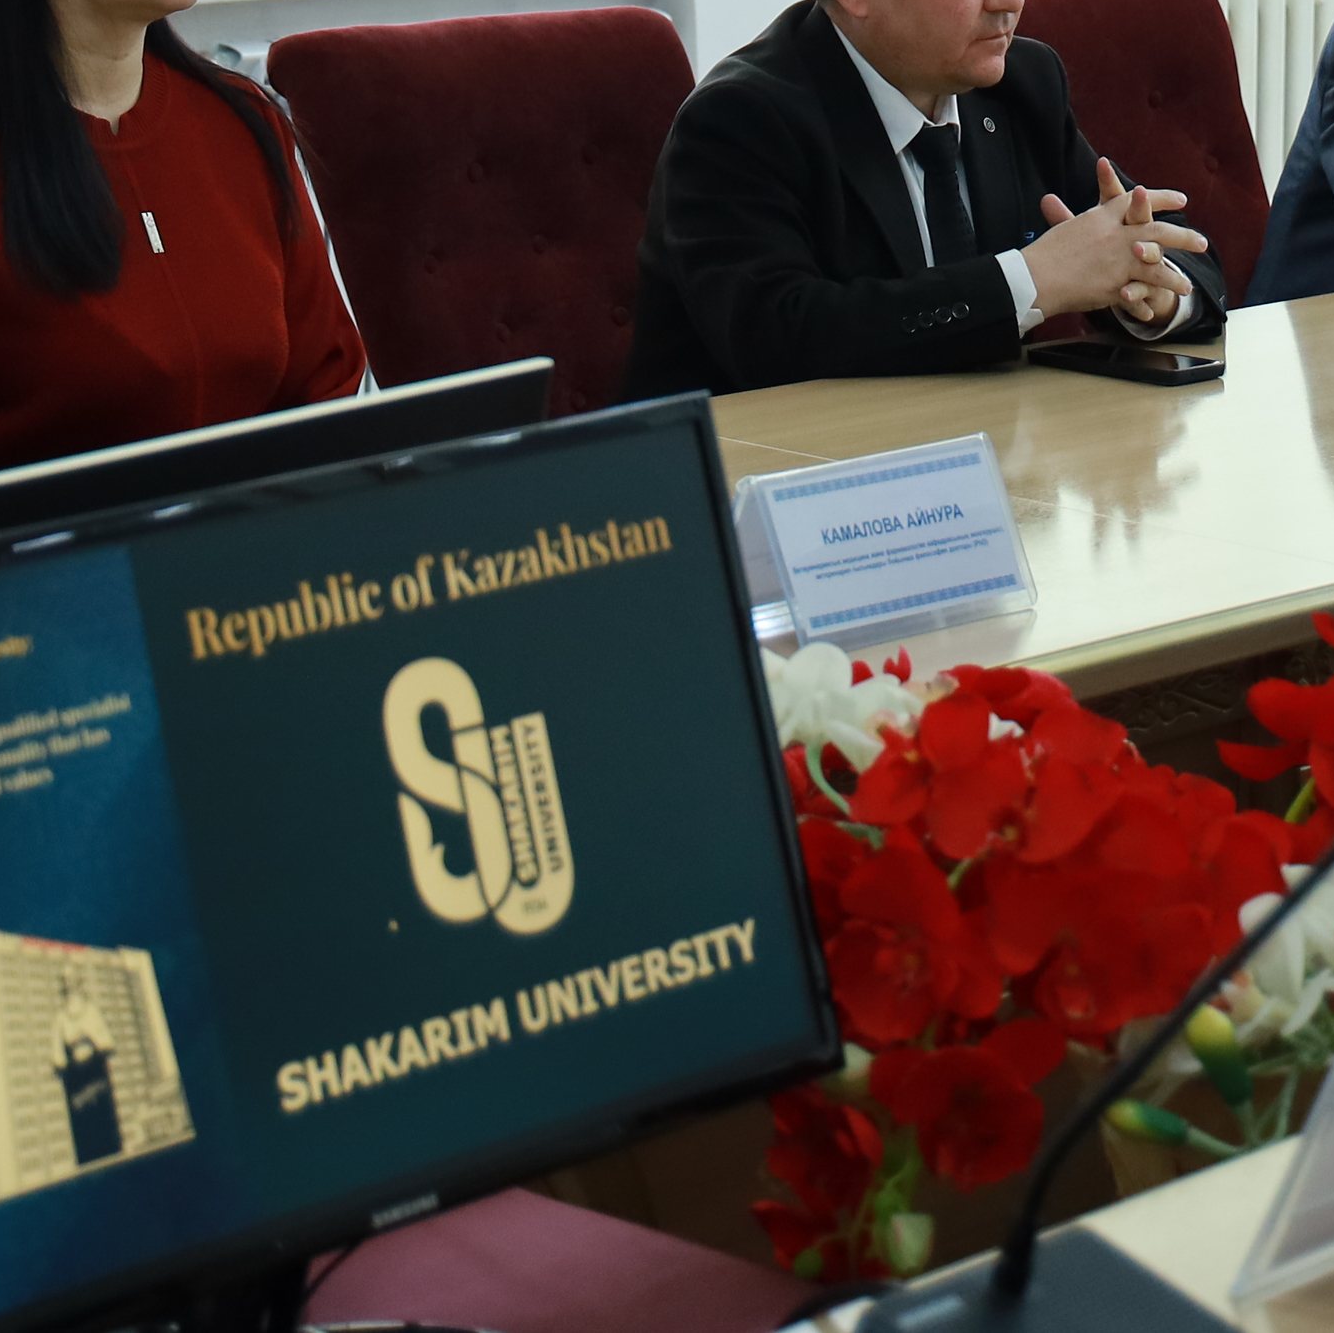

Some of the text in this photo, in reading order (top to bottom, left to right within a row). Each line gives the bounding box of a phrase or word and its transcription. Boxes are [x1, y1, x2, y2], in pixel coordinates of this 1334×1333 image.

[186, 515, 673, 659] Republic of Kazakhstan
[821, 503, 965, 546] КАМАЛОВА АЙНУРА
[522, 722, 565, 874] UNIVERSITY
[275, 918, 757, 1114] SHAKARIM UNIVERSITY
